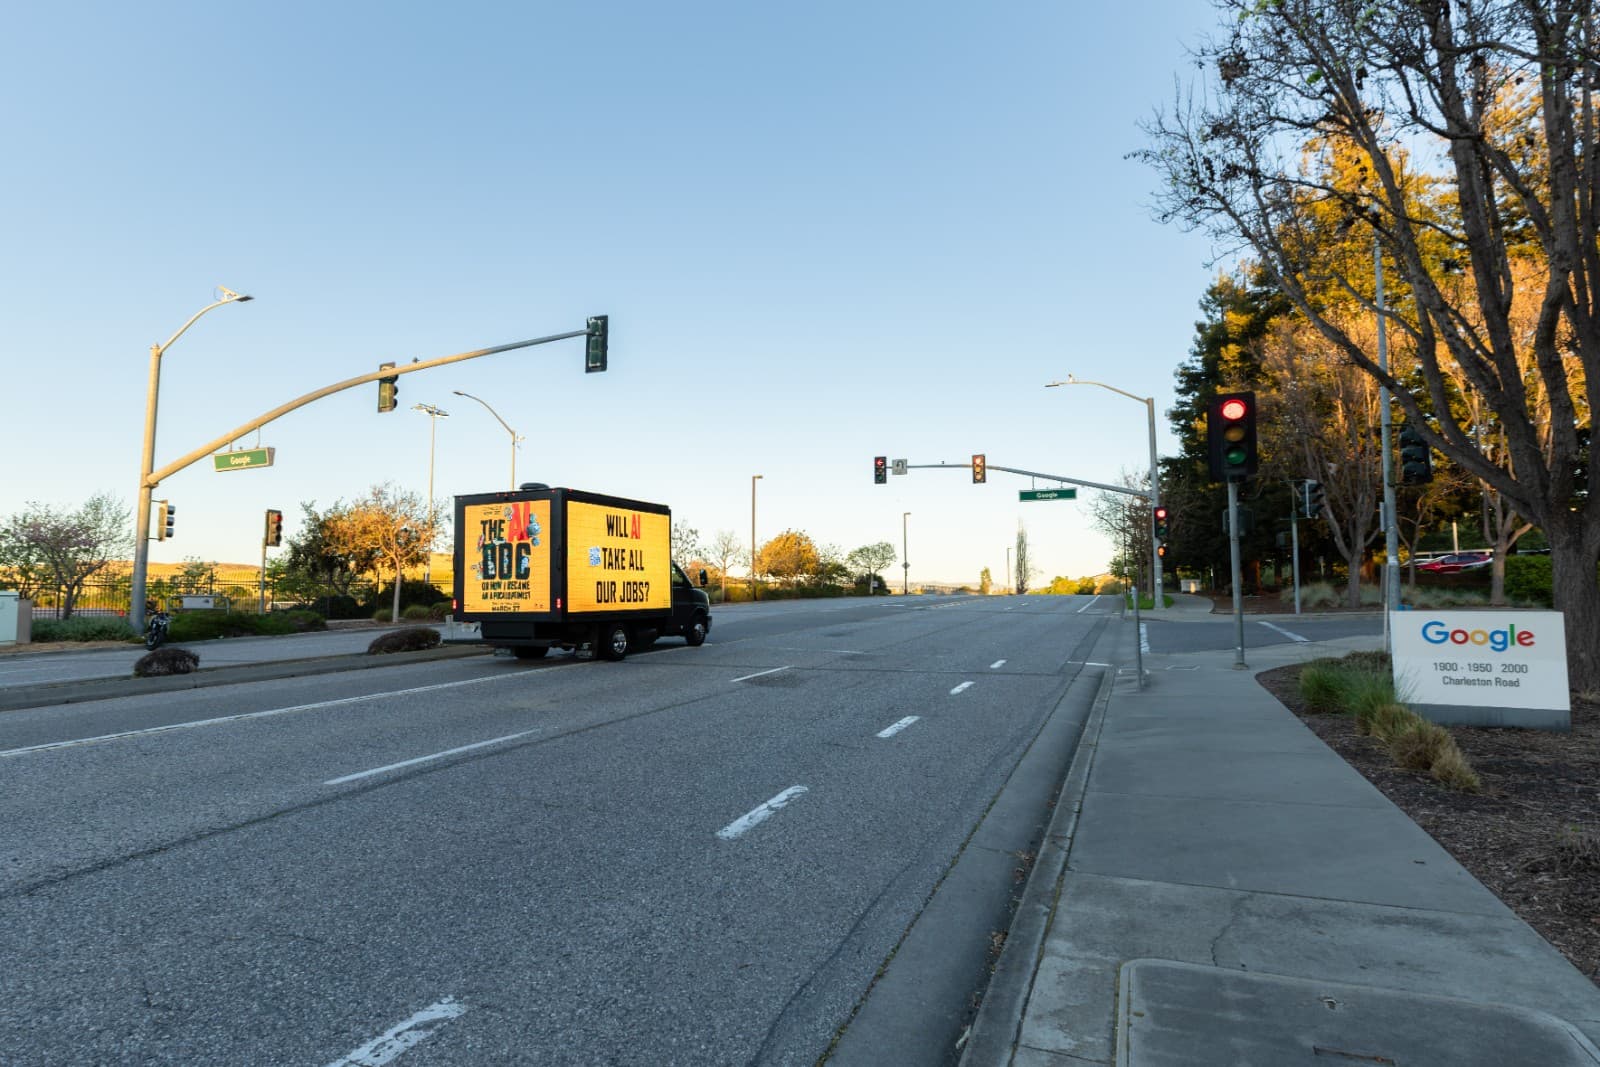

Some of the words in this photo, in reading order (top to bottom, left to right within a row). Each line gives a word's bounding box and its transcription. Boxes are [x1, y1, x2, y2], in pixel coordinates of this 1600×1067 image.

[480, 519, 506, 542] THE
[507, 501, 531, 542] AI
[606, 514, 629, 538] WILL
[630, 513, 641, 540] AI
[482, 542, 532, 580] DOC
[601, 547, 626, 571] TAKE
[629, 549, 645, 571] ALL
[596, 581, 617, 604] OUR
[619, 581, 650, 603] JOBS?
[1421, 620, 1536, 653] Google
[1433, 662, 1458, 672] 1900
[1467, 662, 1493, 673] 1950
[1501, 663, 1529, 674] 2000
[1442, 676, 1493, 687] Charleston
[1495, 677, 1521, 688] Road
